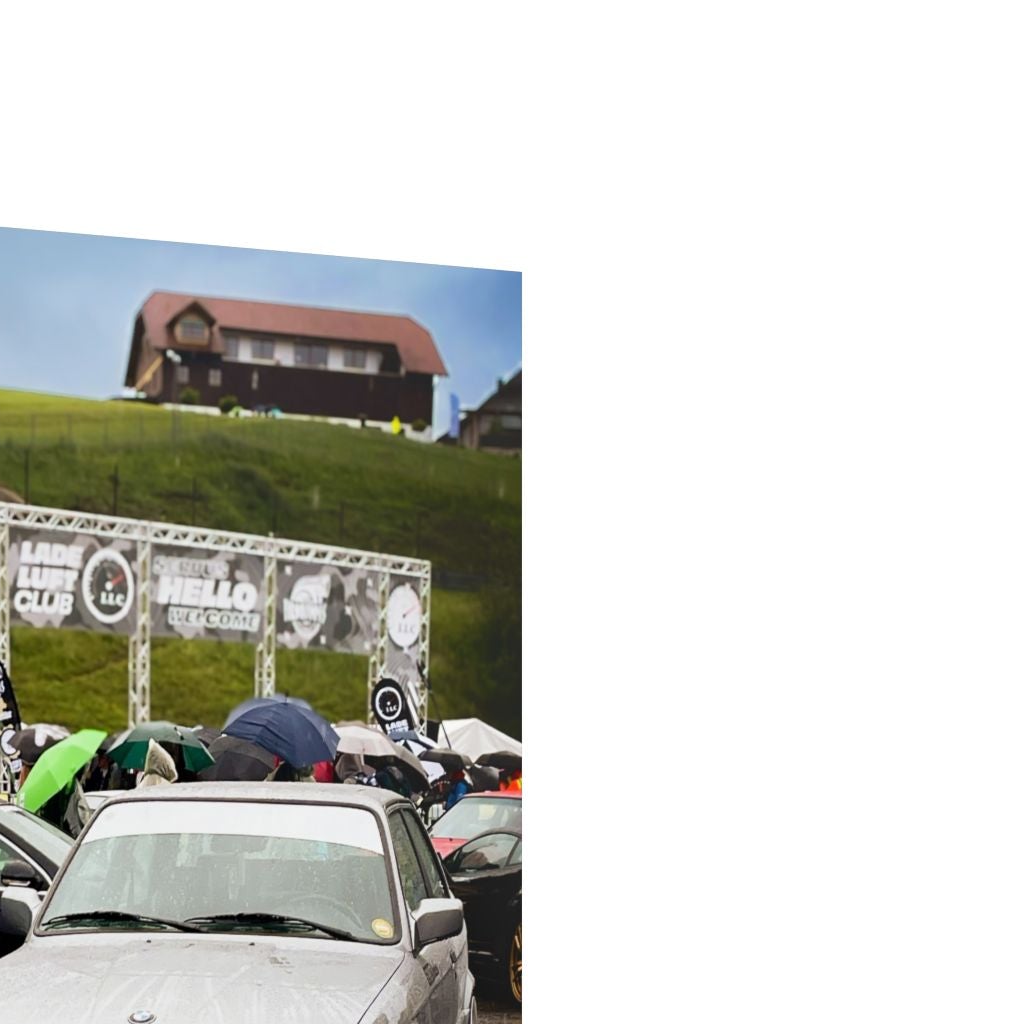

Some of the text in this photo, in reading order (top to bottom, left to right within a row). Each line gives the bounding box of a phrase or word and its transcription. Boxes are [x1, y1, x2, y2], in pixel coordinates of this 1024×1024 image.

[20, 541, 84, 568] LADE
[16, 565, 79, 592] LUFT
[14, 590, 74, 615] CLUB
[100, 591, 126, 607] LLC
[157, 576, 257, 611] HELLO
[168, 606, 260, 632] WELCOME
